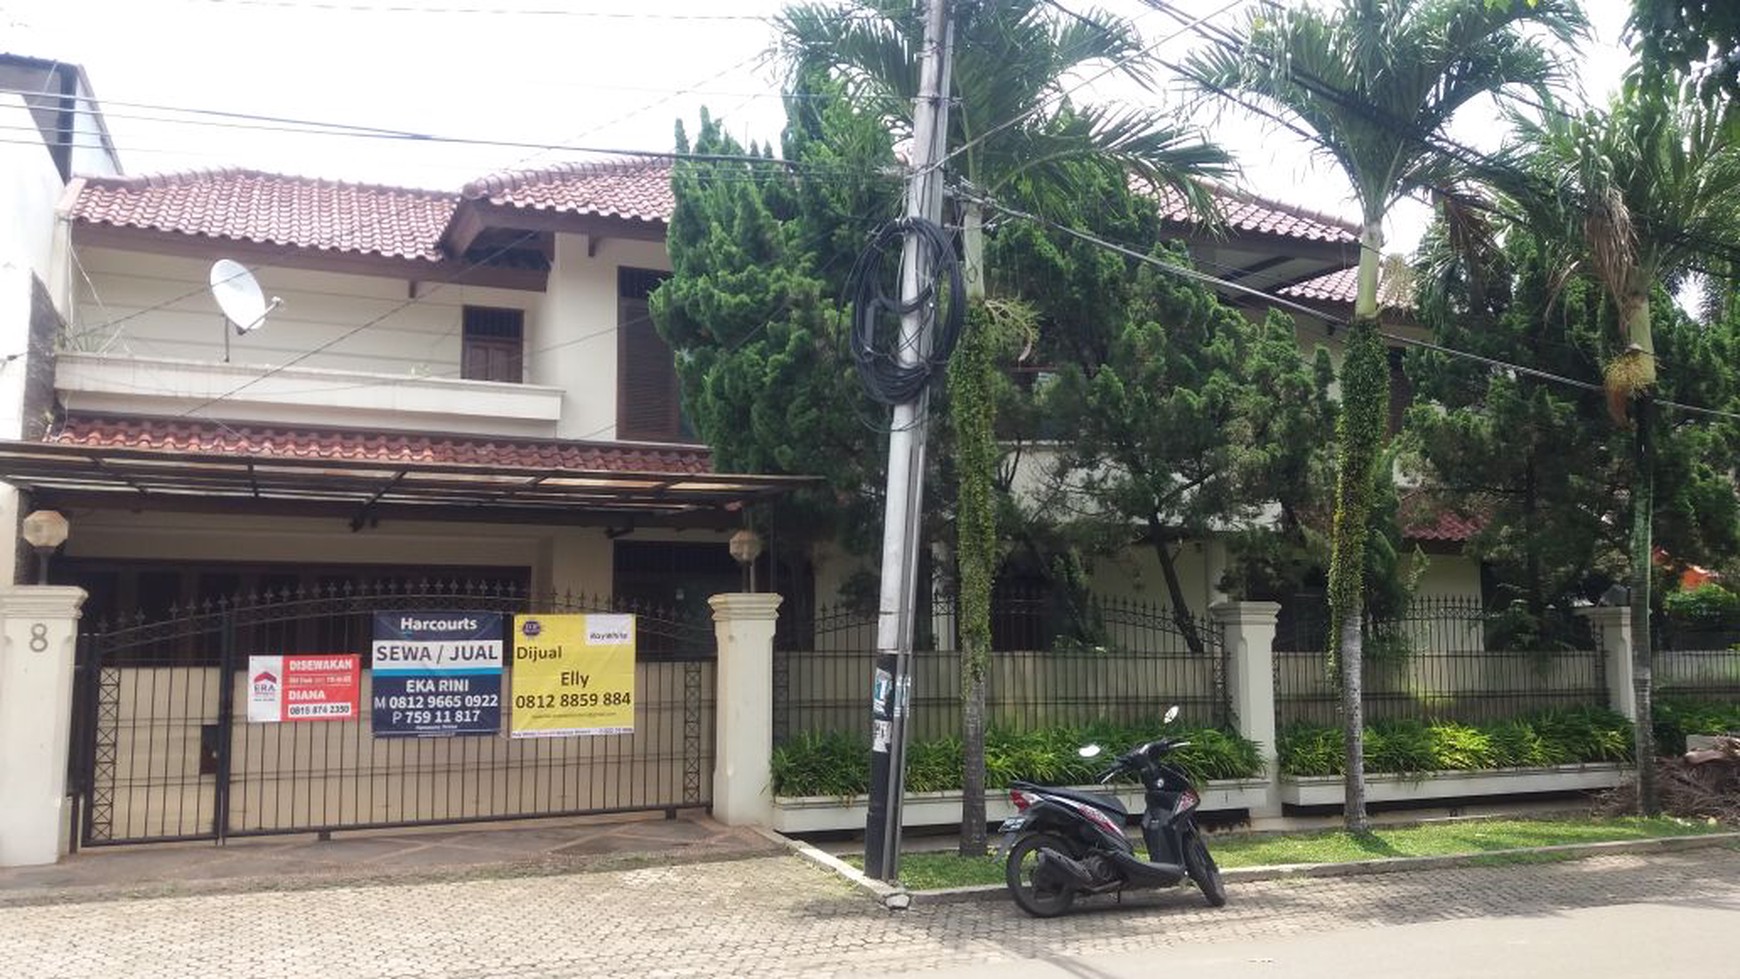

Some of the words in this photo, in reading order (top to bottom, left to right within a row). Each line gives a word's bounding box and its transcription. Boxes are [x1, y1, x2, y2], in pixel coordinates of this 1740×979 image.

[401, 617, 478, 631] Harcourts
[29, 623, 48, 652] 8
[377, 646, 432, 661] SEWA
[436, 644, 444, 665] /
[449, 645, 498, 661] JUAL
[517, 646, 562, 662] Dijual
[289, 659, 353, 671] DISEWAKAN
[406, 680, 435, 692] EKA
[439, 679, 469, 692] RINI
[561, 671, 590, 688] Elly
[254, 684, 276, 692] ERA
[289, 690, 325, 700] DIANA
[374, 697, 385, 709] M
[389, 697, 424, 709] 0812
[427, 695, 462, 708] 9665
[464, 694, 498, 707] 0922
[515, 695, 555, 709] 0812
[560, 693, 598, 707] 8859
[603, 692, 631, 706] 884
[393, 712, 402, 724] P
[405, 711, 431, 724] 759
[435, 711, 451, 722] 11
[455, 710, 481, 722] 817
